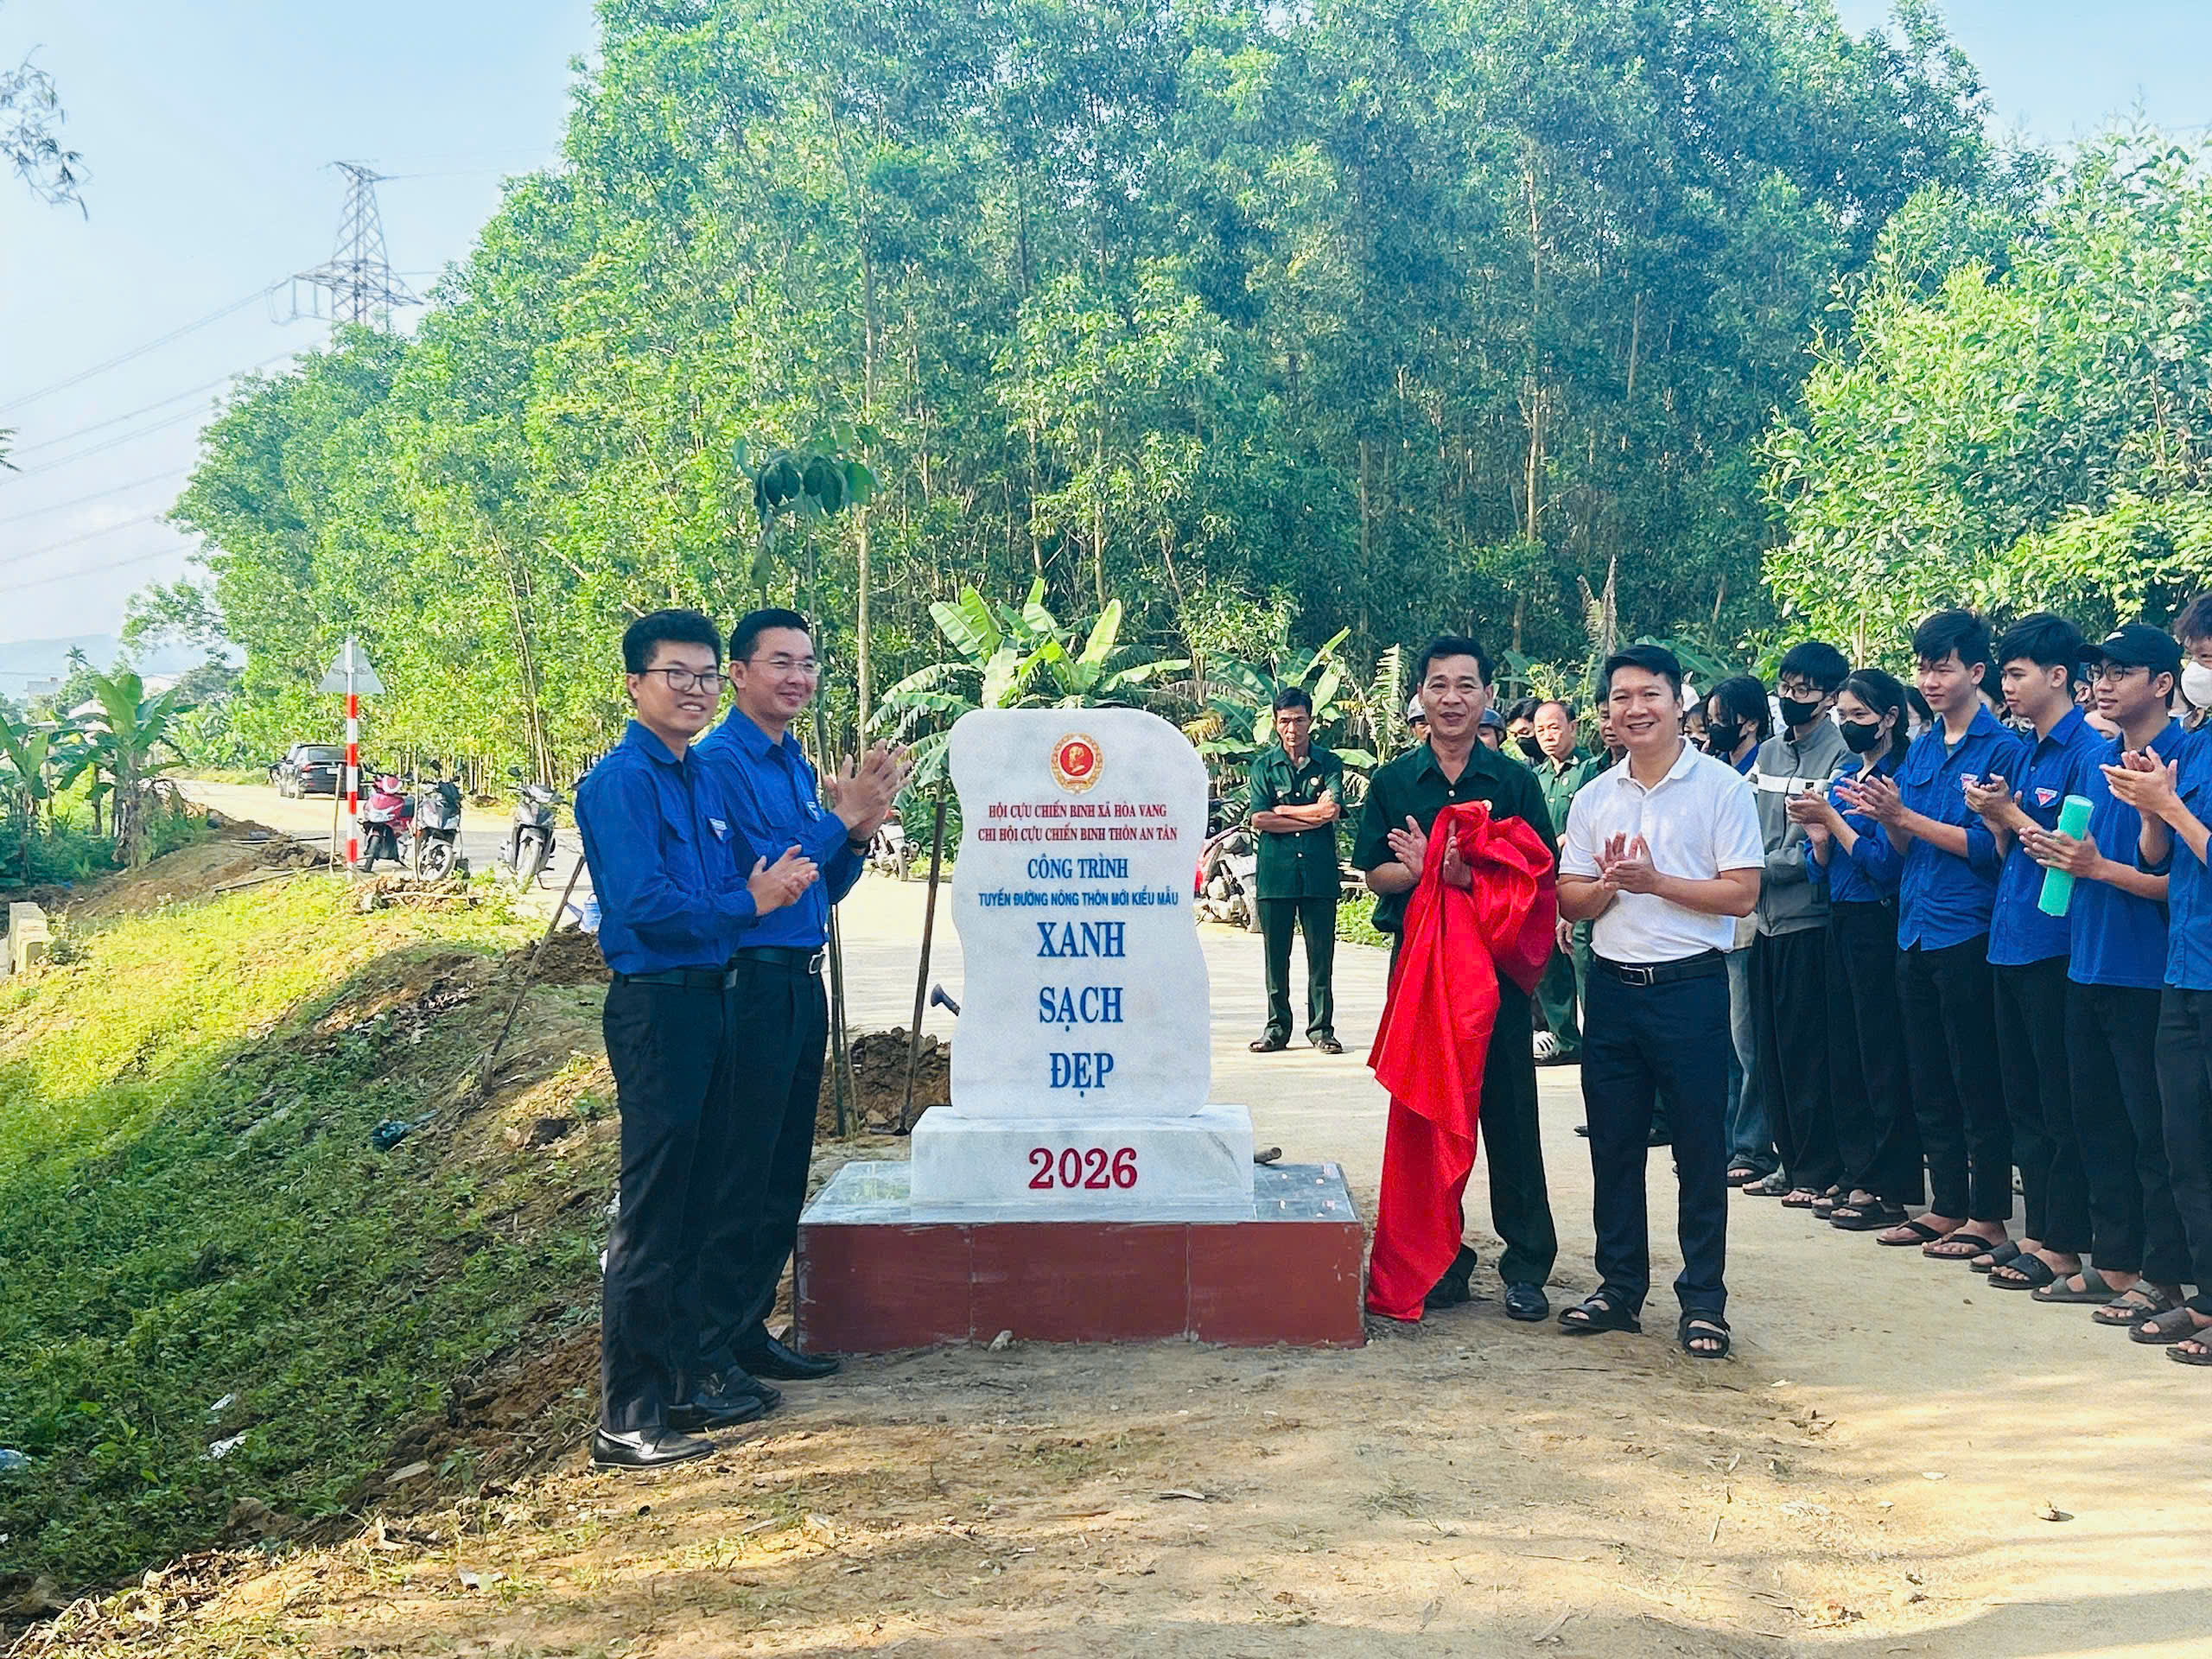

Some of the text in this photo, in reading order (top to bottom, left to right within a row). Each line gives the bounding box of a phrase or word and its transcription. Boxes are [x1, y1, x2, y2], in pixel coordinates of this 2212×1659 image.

[988, 799, 1167, 820] HỘI CỰU CHIẾN BINH XÃ HÒA VANG
[978, 823, 1178, 843] CHI HỘI CỰU CHIẾN BINH THÔN AN TÂN
[1027, 852, 1129, 879] CÔNG TRÌNH
[978, 887, 1011, 906] TUYẾN
[1013, 889, 1048, 906] ĐƯỜNG
[1051, 889, 1079, 906] NÔNG
[1082, 889, 1109, 906] THÔN
[1111, 888, 1129, 906] MỚI
[1037, 922, 1126, 957] XANH
[1039, 987, 1123, 1033] SẠCH
[1049, 1052, 1115, 1098] ĐẸP
[1028, 1147, 1138, 1190] 2026
